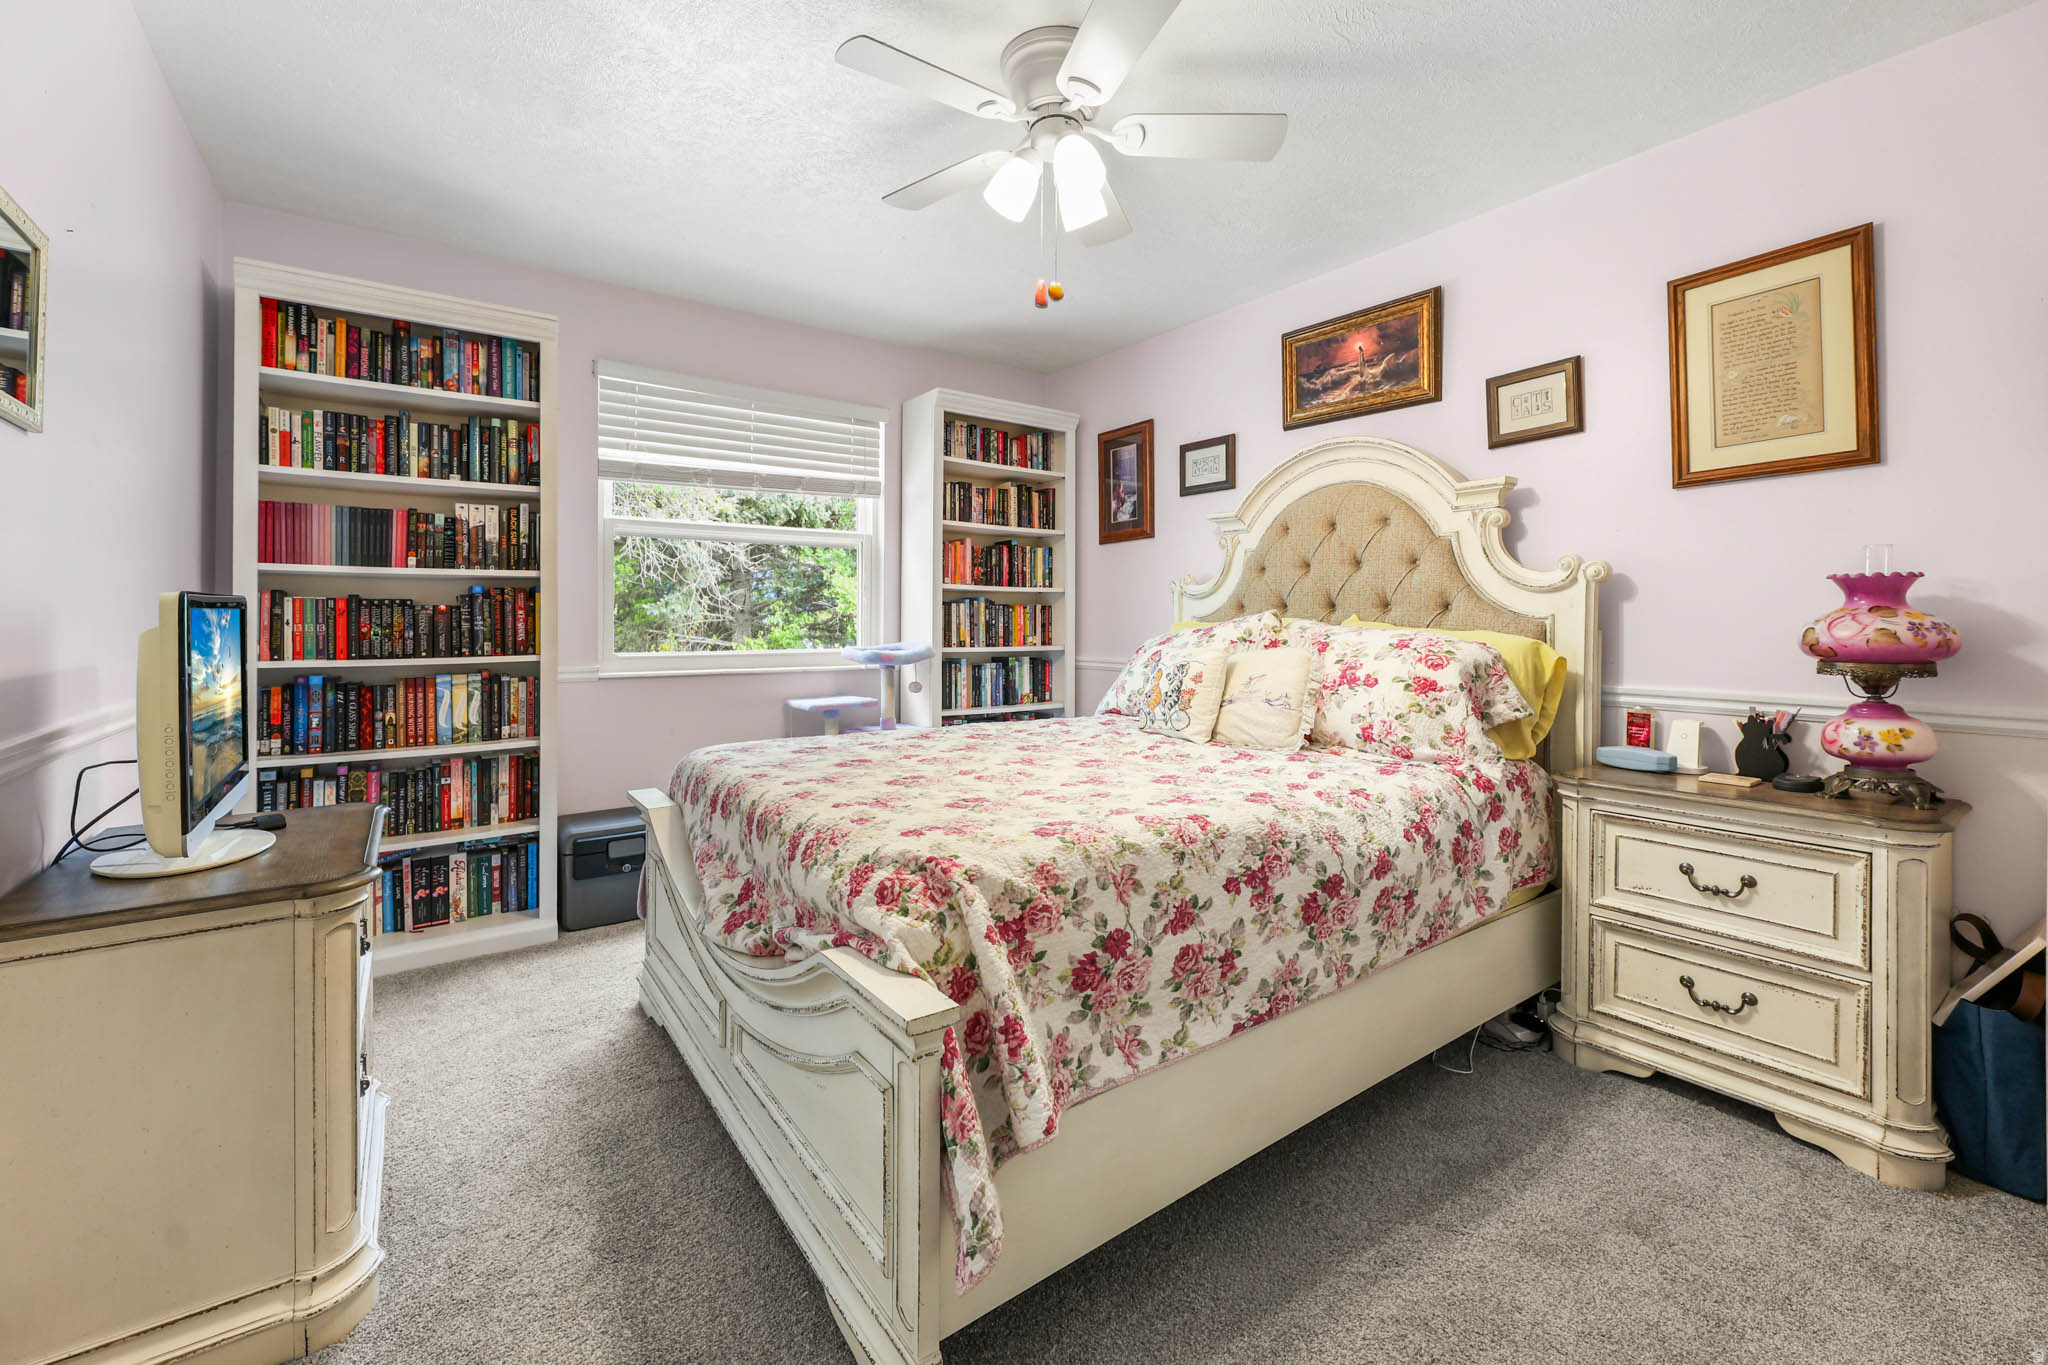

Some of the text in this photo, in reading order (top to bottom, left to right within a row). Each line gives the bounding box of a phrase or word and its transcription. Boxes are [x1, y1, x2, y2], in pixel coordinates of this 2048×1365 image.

[314, 431, 323, 462] FLAWED
[510, 509, 518, 529] BLACK
[510, 531, 518, 545] SUN
[348, 702, 357, 721] GLASS
[407, 693, 415, 717] BURNING
